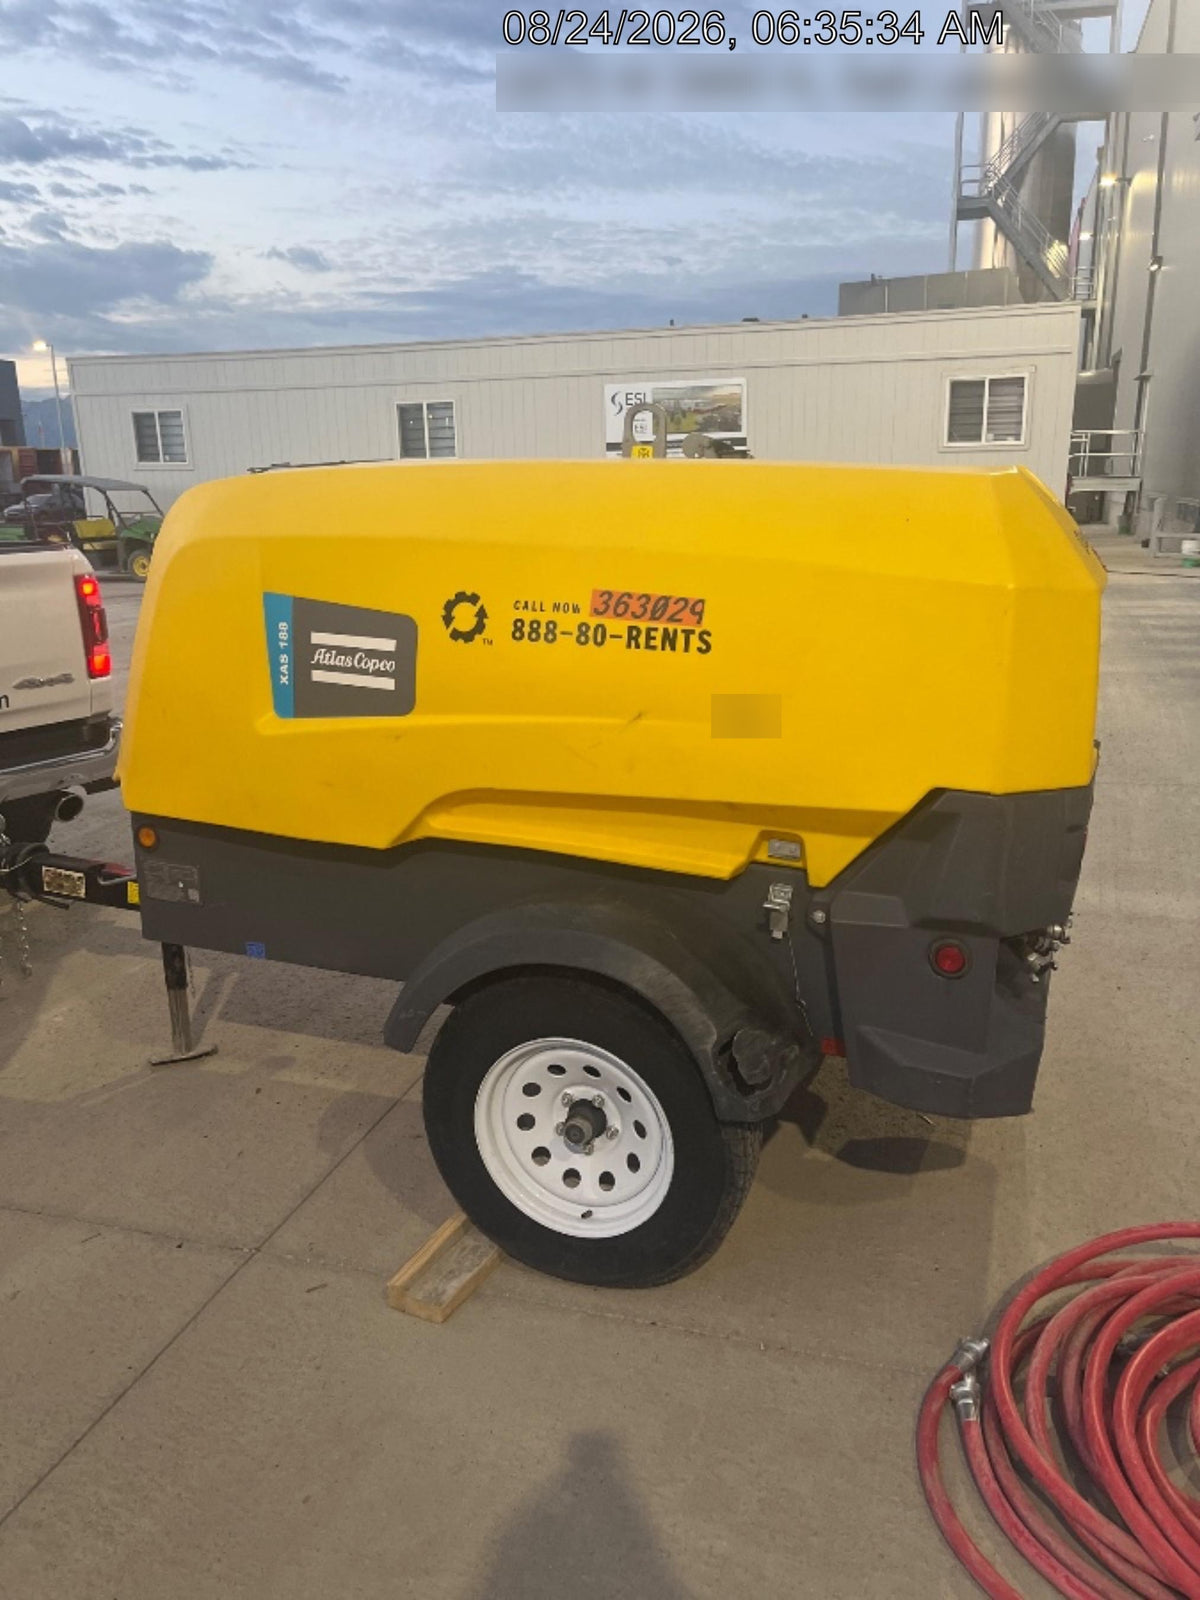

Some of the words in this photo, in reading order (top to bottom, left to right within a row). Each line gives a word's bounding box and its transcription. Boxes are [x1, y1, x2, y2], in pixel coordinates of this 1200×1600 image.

[513, 600, 545, 612] CALL
[552, 602, 581, 614] NOW
[593, 590, 705, 625] 363029
[278, 621, 289, 648] 188
[511, 618, 712, 655] 888-80-RENTS
[279, 654, 289, 686] XAS
[310, 648, 352, 667] Atlas
[353, 651, 396, 673] Copco
